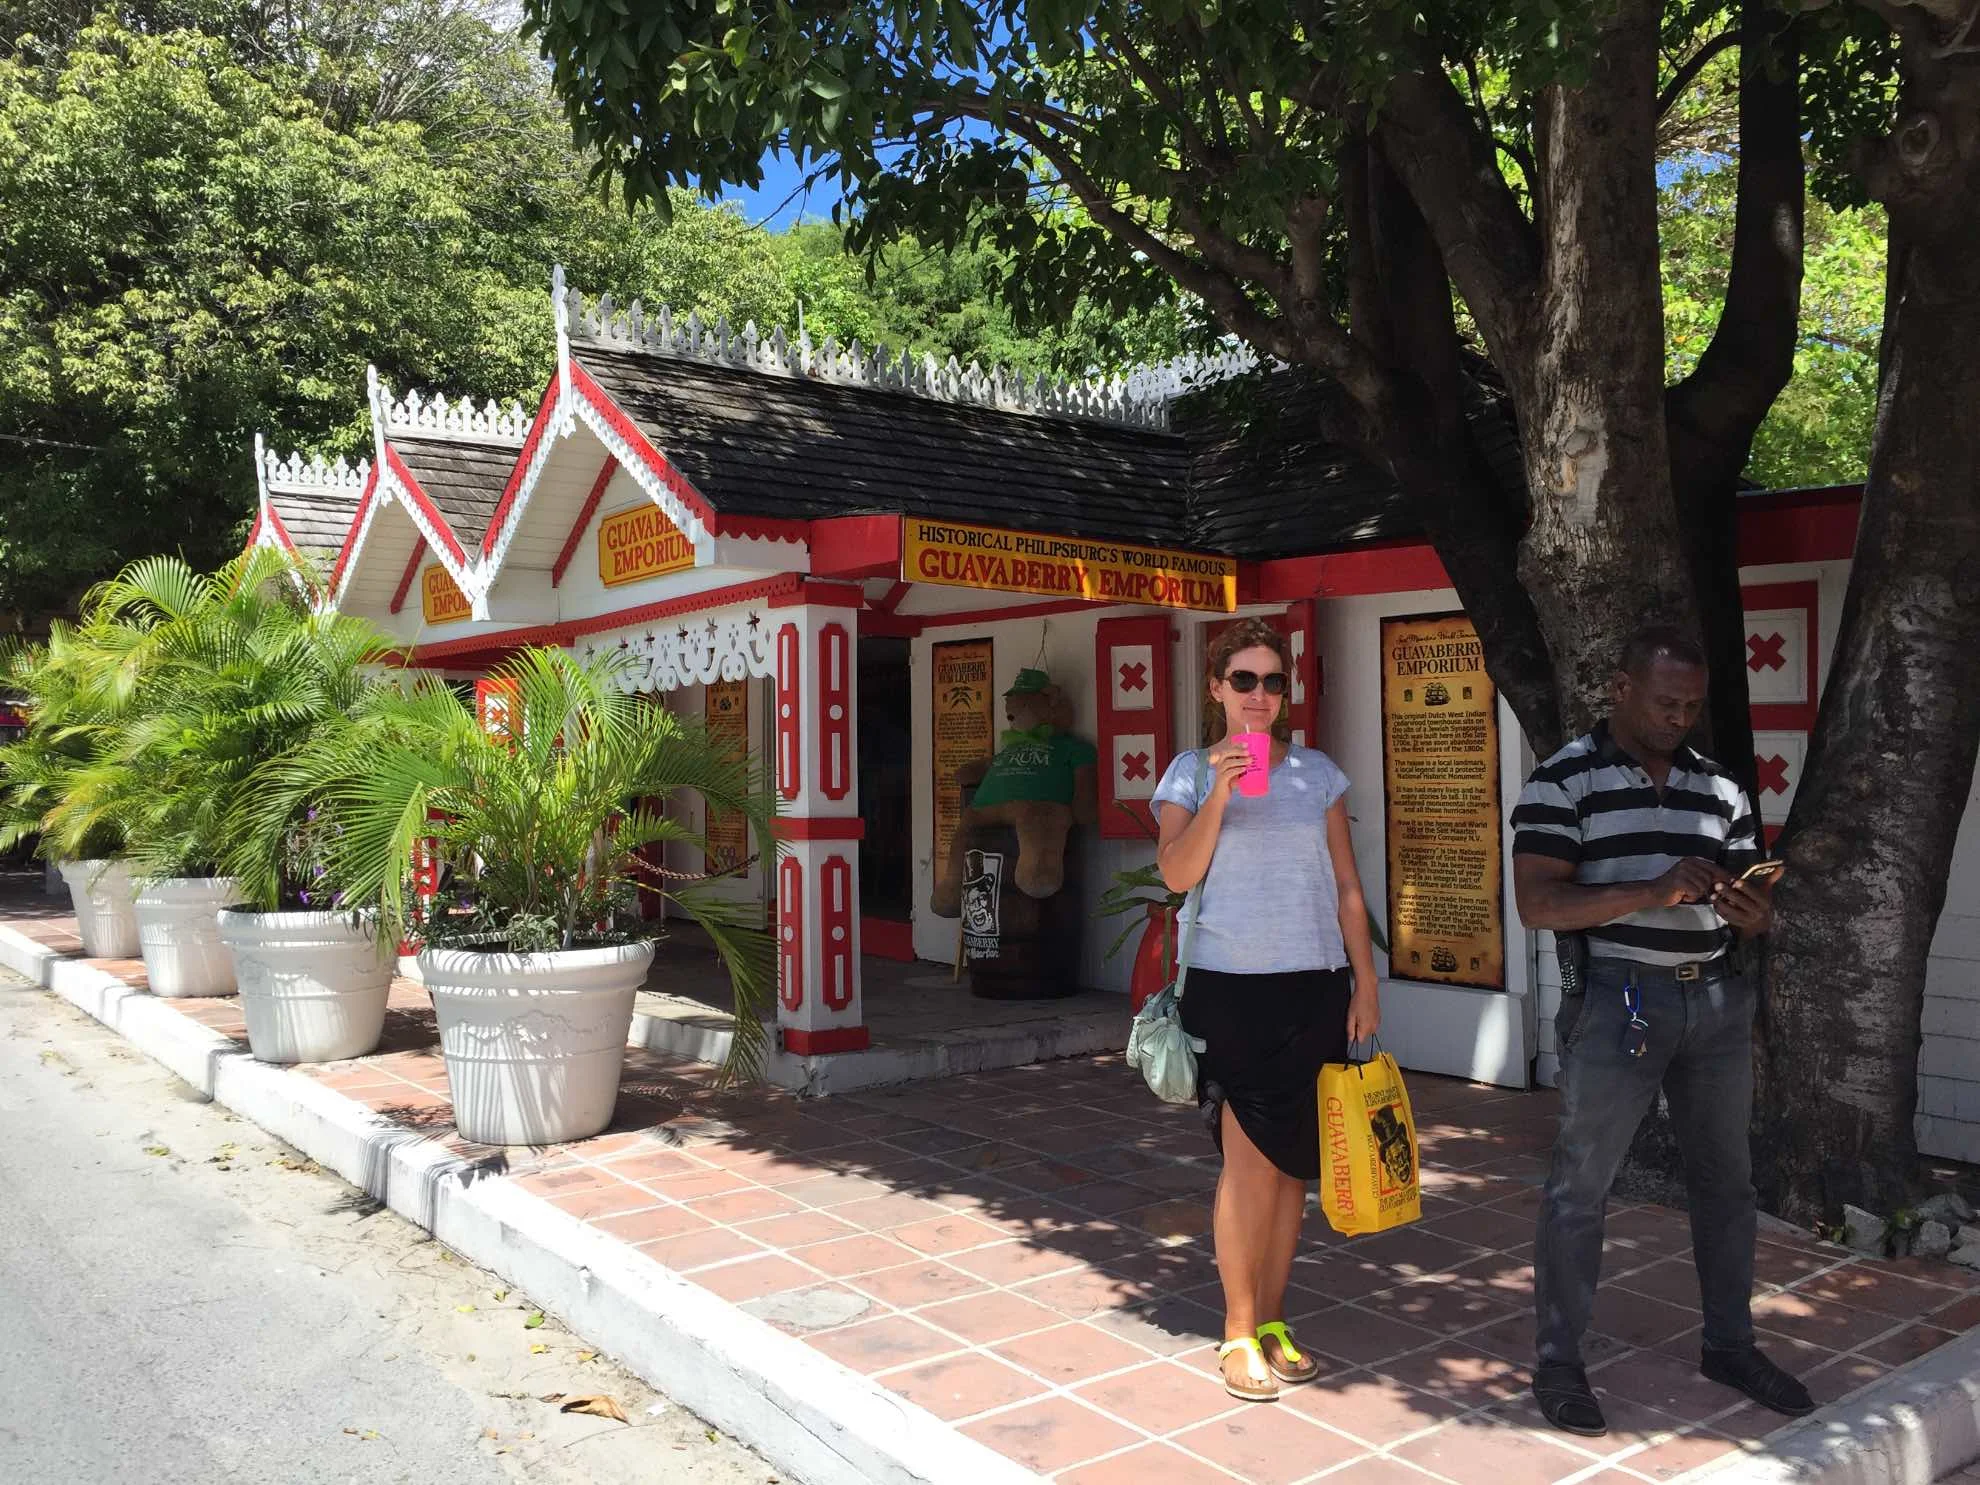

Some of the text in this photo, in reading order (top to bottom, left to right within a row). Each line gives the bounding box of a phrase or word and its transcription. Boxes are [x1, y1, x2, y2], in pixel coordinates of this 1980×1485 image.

[607, 511, 677, 550] GUAVABE
[919, 525, 1226, 576] HISTORICAL PHILIPSBURG'S WORLD FAMOUS
[614, 533, 695, 577] EMPORIUM
[918, 548, 1224, 607] GUAVABERRY EMPORIUM
[432, 592, 470, 616] EMPOR
[1397, 658, 1480, 676] EMPORIUM
[1008, 750, 1049, 767] RUM
[1326, 1096, 1354, 1217] GUAVABERR
